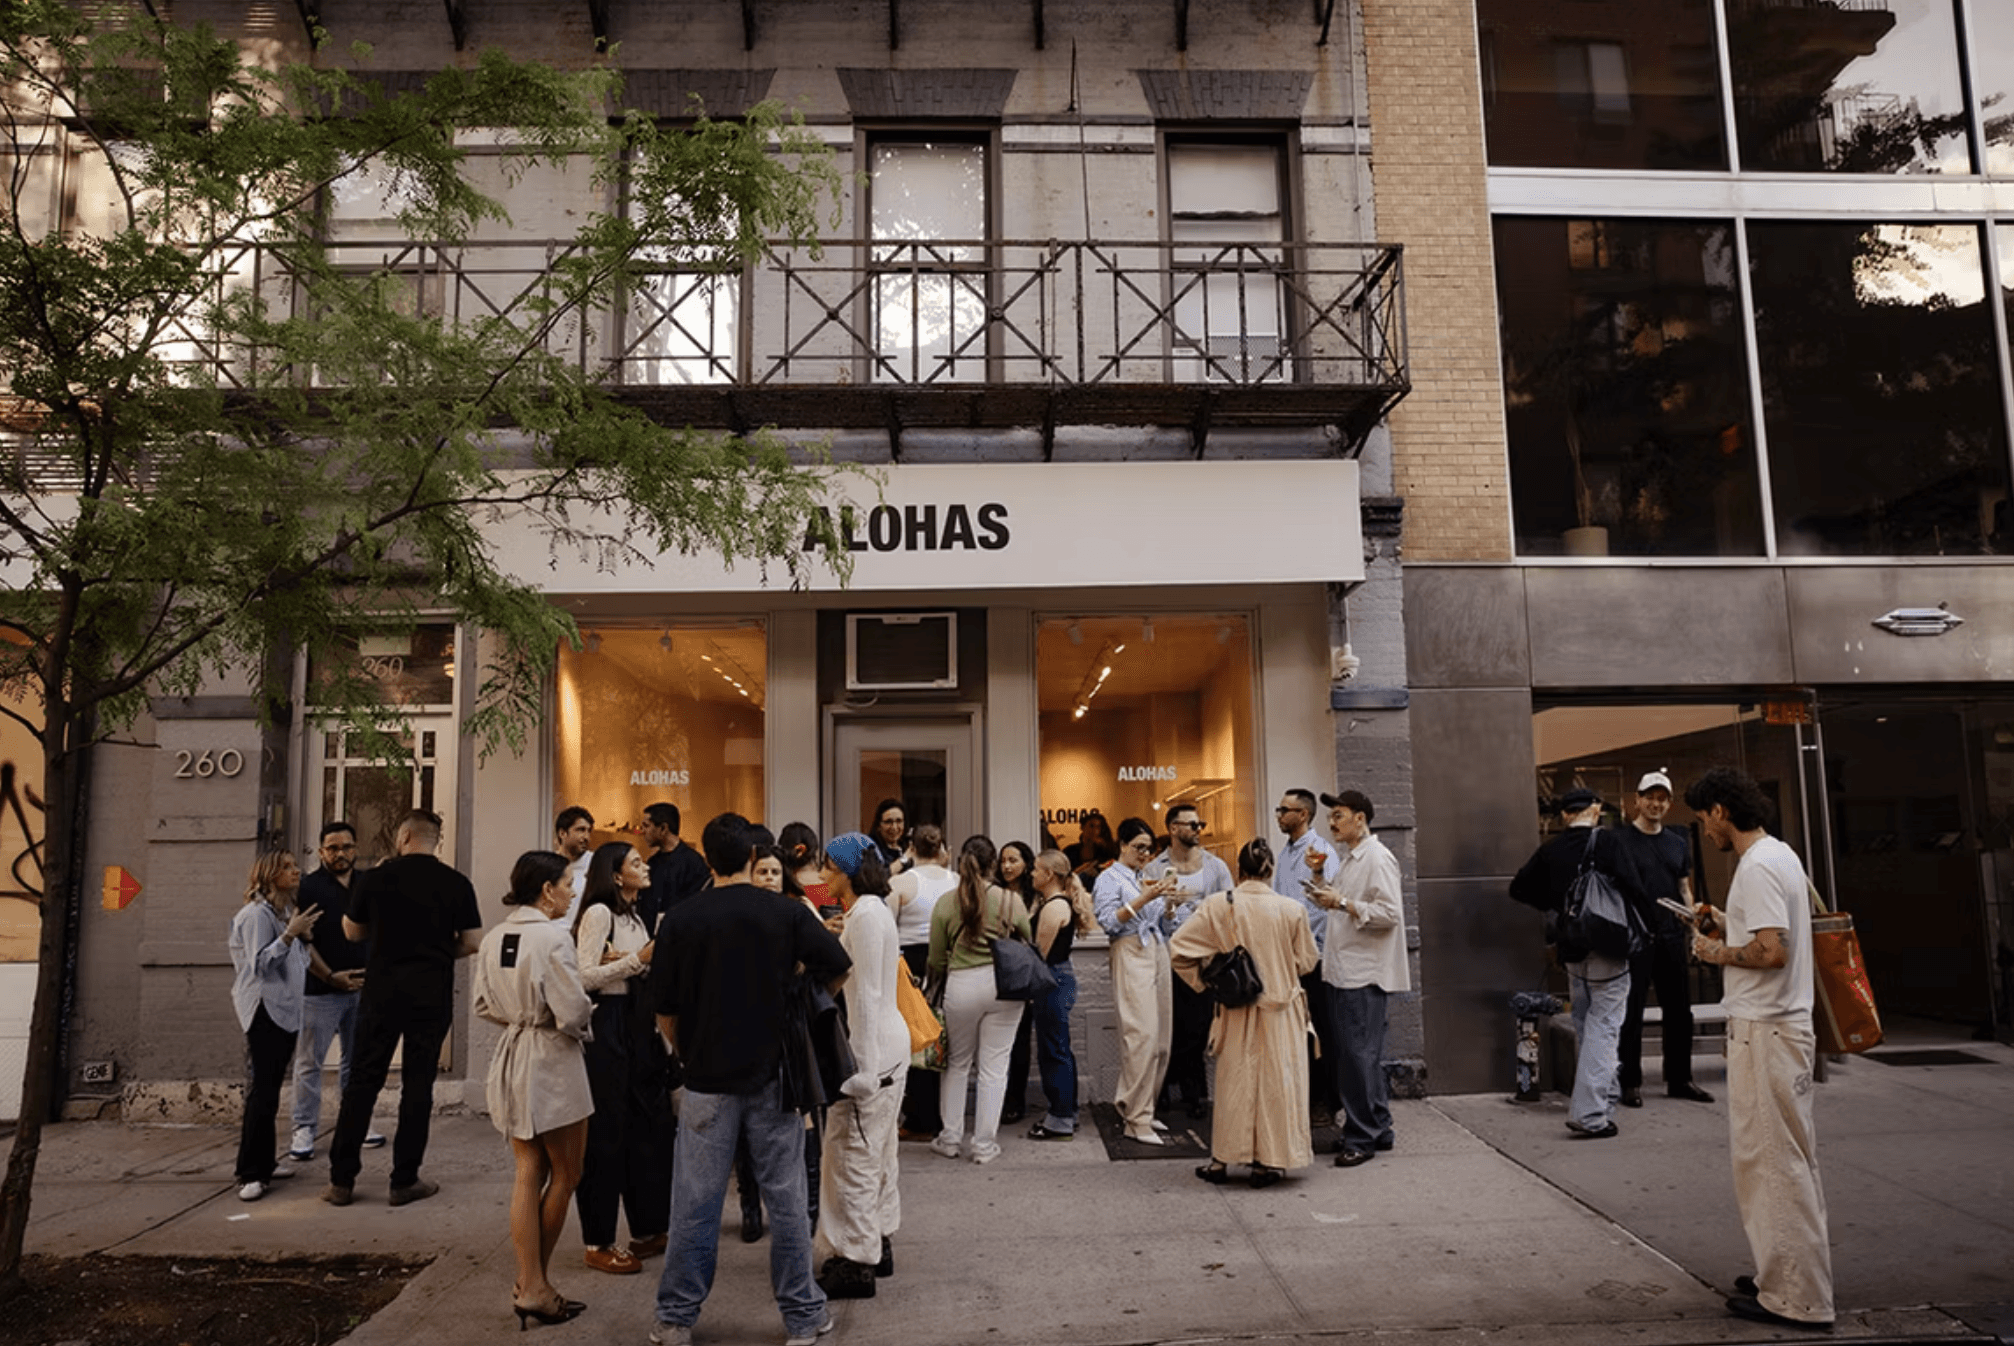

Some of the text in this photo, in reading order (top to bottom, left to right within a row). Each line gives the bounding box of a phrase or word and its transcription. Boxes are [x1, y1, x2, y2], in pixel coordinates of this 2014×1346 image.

[802, 503, 1010, 552] ALOHAS
[360, 656, 404, 679] 260
[174, 748, 243, 777] 260
[1117, 765, 1178, 781] ALOHAS
[630, 770, 690, 786] ALOHAS
